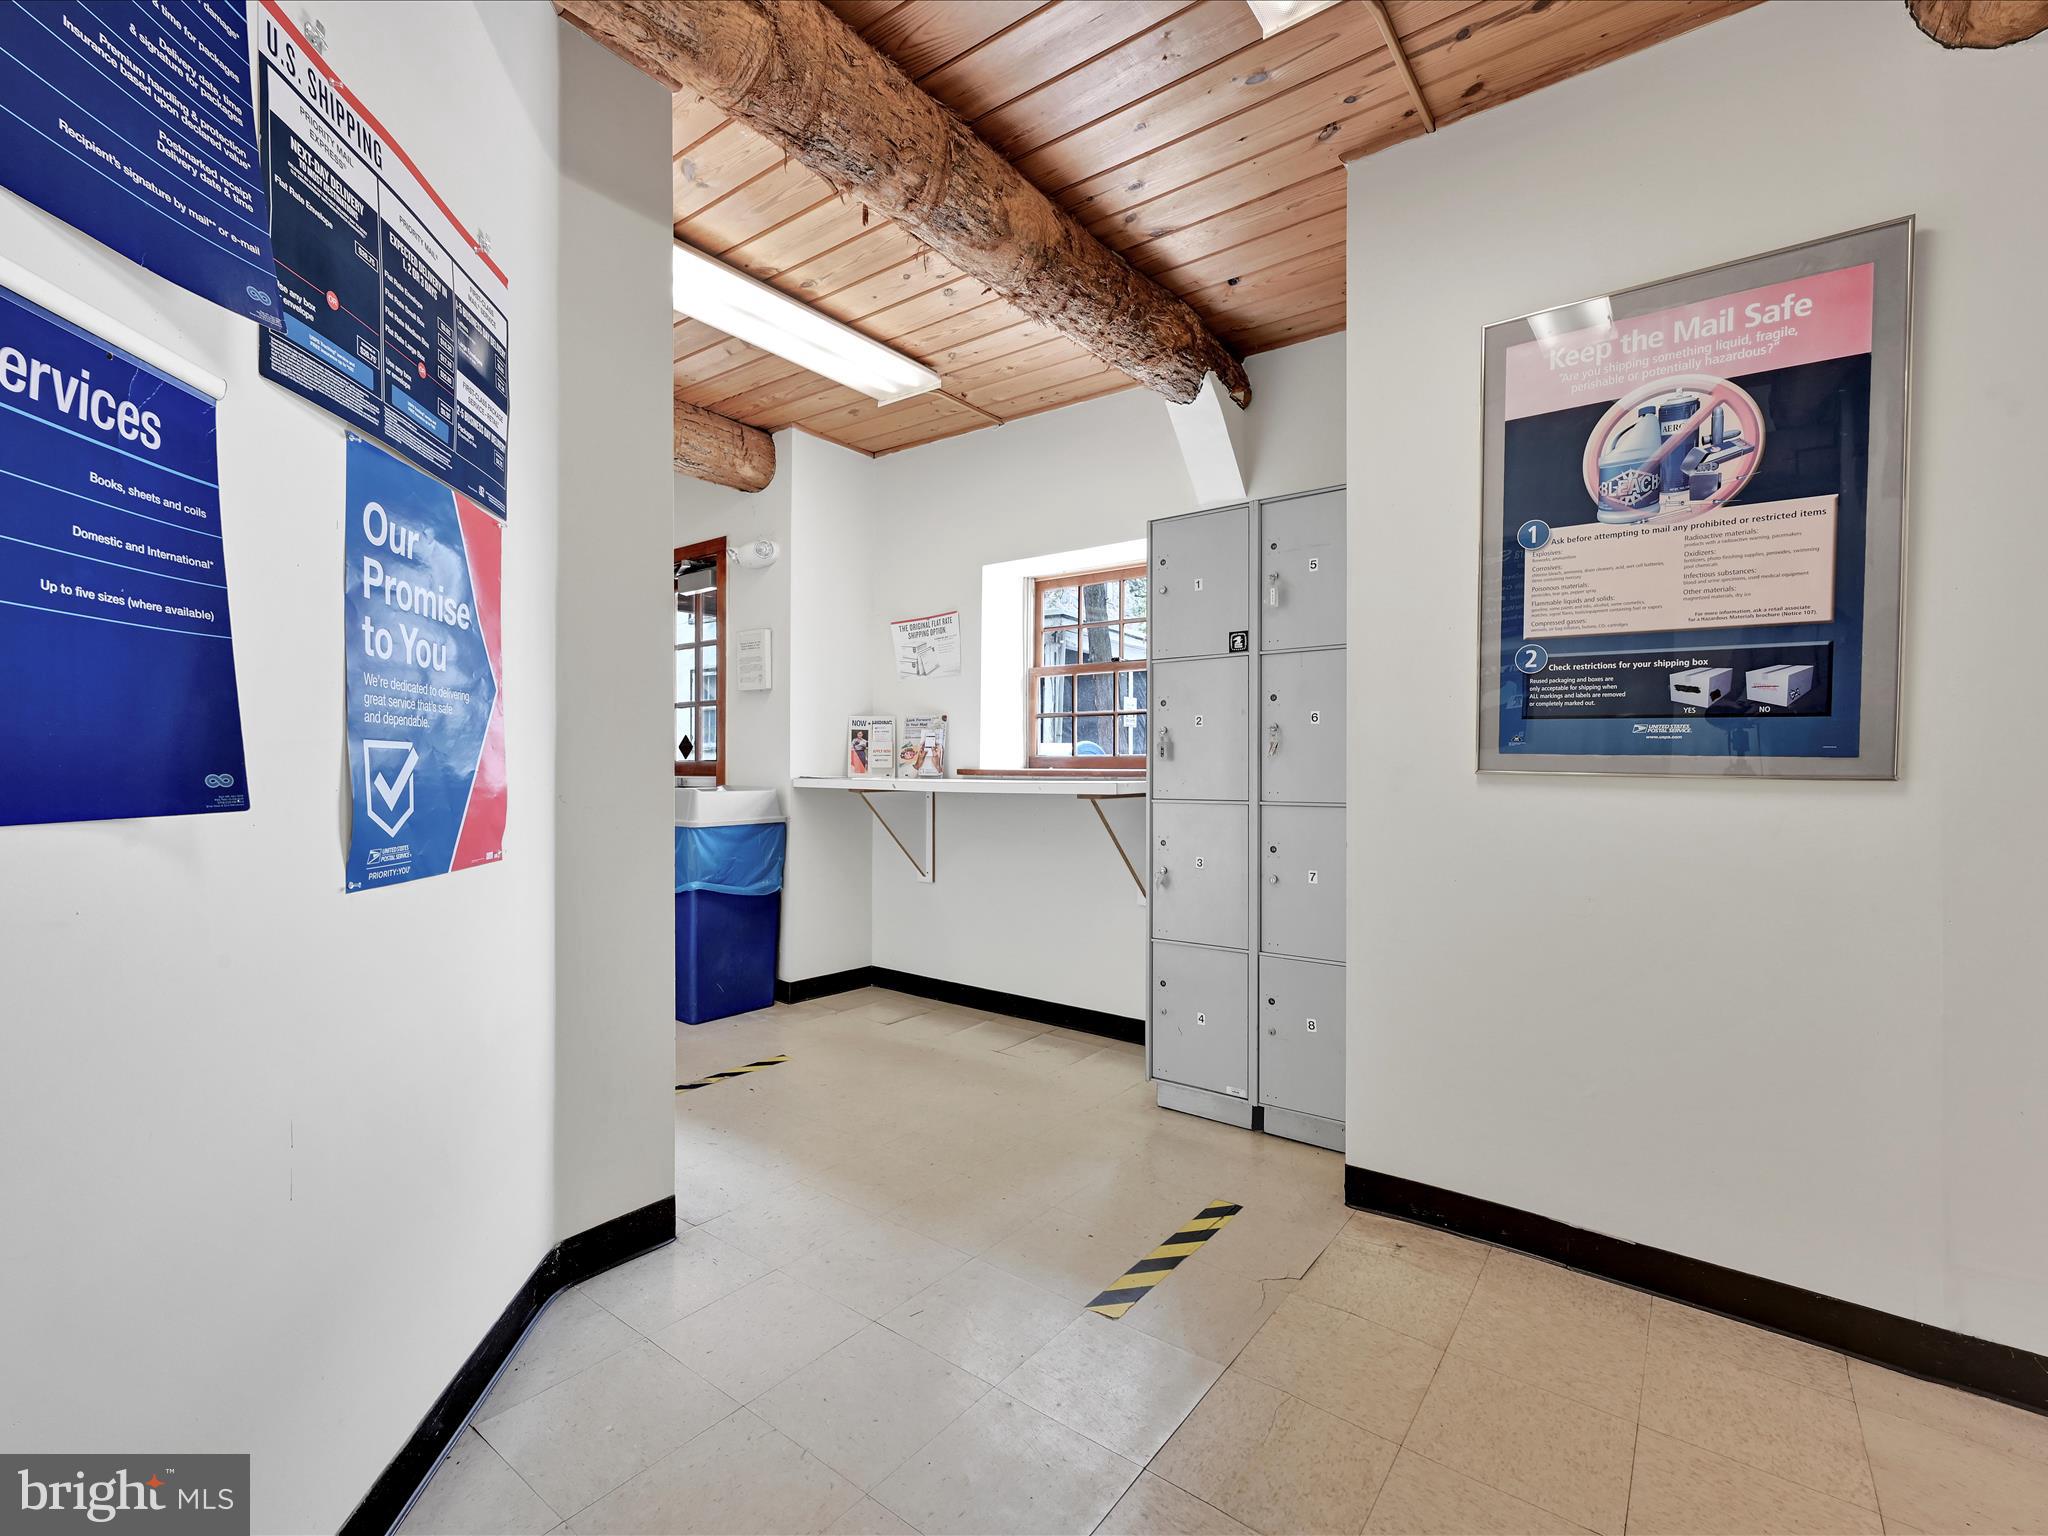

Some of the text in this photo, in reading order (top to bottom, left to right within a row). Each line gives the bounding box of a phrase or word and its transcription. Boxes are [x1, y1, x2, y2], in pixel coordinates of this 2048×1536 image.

[161, 4, 240, 83] time for packages
[63, 14, 117, 68] Insurance
[120, 63, 151, 96] based
[154, 93, 179, 118] upon
[181, 116, 222, 151] declared
[129, 23, 243, 126] & signature for packages
[159, 37, 242, 116] Delivery date, time
[99, 32, 246, 159] Premium handling & protection
[266, 19, 302, 83] U.S.
[307, 67, 383, 170] SHIPPING
[300, 105, 354, 168] PRIORITY MAIL
[157, 140, 253, 213] Delivery date & time
[159, 129, 218, 179] Postmarked
[220, 176, 252, 202] receipt
[290, 136, 330, 184] NEXT-DAY
[330, 174, 364, 215] DELIVERY
[58, 118, 121, 170] Recipient's
[123, 165, 172, 203] signature
[174, 197, 186, 214] by
[218, 227, 228, 237] or
[231, 234, 260, 256] e-mail
[275, 174, 333, 229] Flat Rate Envelope
[283, 298, 314, 322] envelope
[289, 290, 316, 312] any box
[1550, 293, 1813, 371] Keep the Mail Safe
[1582, 368, 1600, 381] you
[1604, 358, 1649, 374] shipping
[1652, 343, 1712, 363] something
[1716, 335, 1752, 351] liquid,
[1756, 326, 1798, 342] fragile,
[1571, 374, 1624, 394] perishable
[1628, 372, 1640, 381] or
[1642, 359, 1702, 380] potentially
[0, 346, 161, 450] ervices
[89, 471, 207, 519] Books, sheets and coils
[1600, 474, 1660, 497] BLEACH
[72, 525, 123, 549] Domestic
[125, 540, 145, 554] and
[363, 502, 420, 559] Our
[1528, 525, 1537, 544] 1
[1551, 537, 1564, 545] Ask
[1567, 536, 1592, 544] before
[1594, 528, 1639, 540] attempting
[1652, 525, 1670, 534] mail
[1690, 517, 1736, 531] prohibited
[1752, 511, 1797, 523] restricted
[1800, 508, 1827, 517] items
[1685, 532, 1723, 541] Radioactive
[1725, 528, 1759, 537] materials:
[1310, 560, 1317, 570] 5
[1684, 549, 1716, 558] Oxidizers:
[1196, 580, 1201, 589] 1
[1683, 571, 1716, 580] Infectious
[1718, 568, 1757, 576] substances:
[40, 578, 215, 622] Up to five sizes (where available)
[364, 556, 471, 630] Promise
[1703, 586, 1736, 594] materials:
[908, 627, 946, 639] SHIPPING OPTION
[910, 622, 930, 631] ORIGINAL
[932, 619, 941, 627] FLAT
[1531, 619, 1565, 627] Compressed
[362, 616, 447, 672] to You
[1525, 650, 1537, 668] 2
[1573, 662, 1616, 670] restrictions
[1633, 661, 1651, 670] your
[1654, 659, 1690, 668] shipping
[1692, 658, 1708, 666] box
[363, 672, 470, 705] We're dedicated to delivering
[1578, 684, 1601, 692] shipping
[364, 694, 452, 714] great service that's safe
[364, 712, 430, 728] and dependable.
[1196, 717, 1202, 726] 2
[1311, 713, 1318, 722] 6
[1197, 859, 1202, 867] 3
[1310, 872, 1316, 882] 7
[1198, 1015, 1204, 1023] 4
[1308, 1021, 1315, 1030] 8
